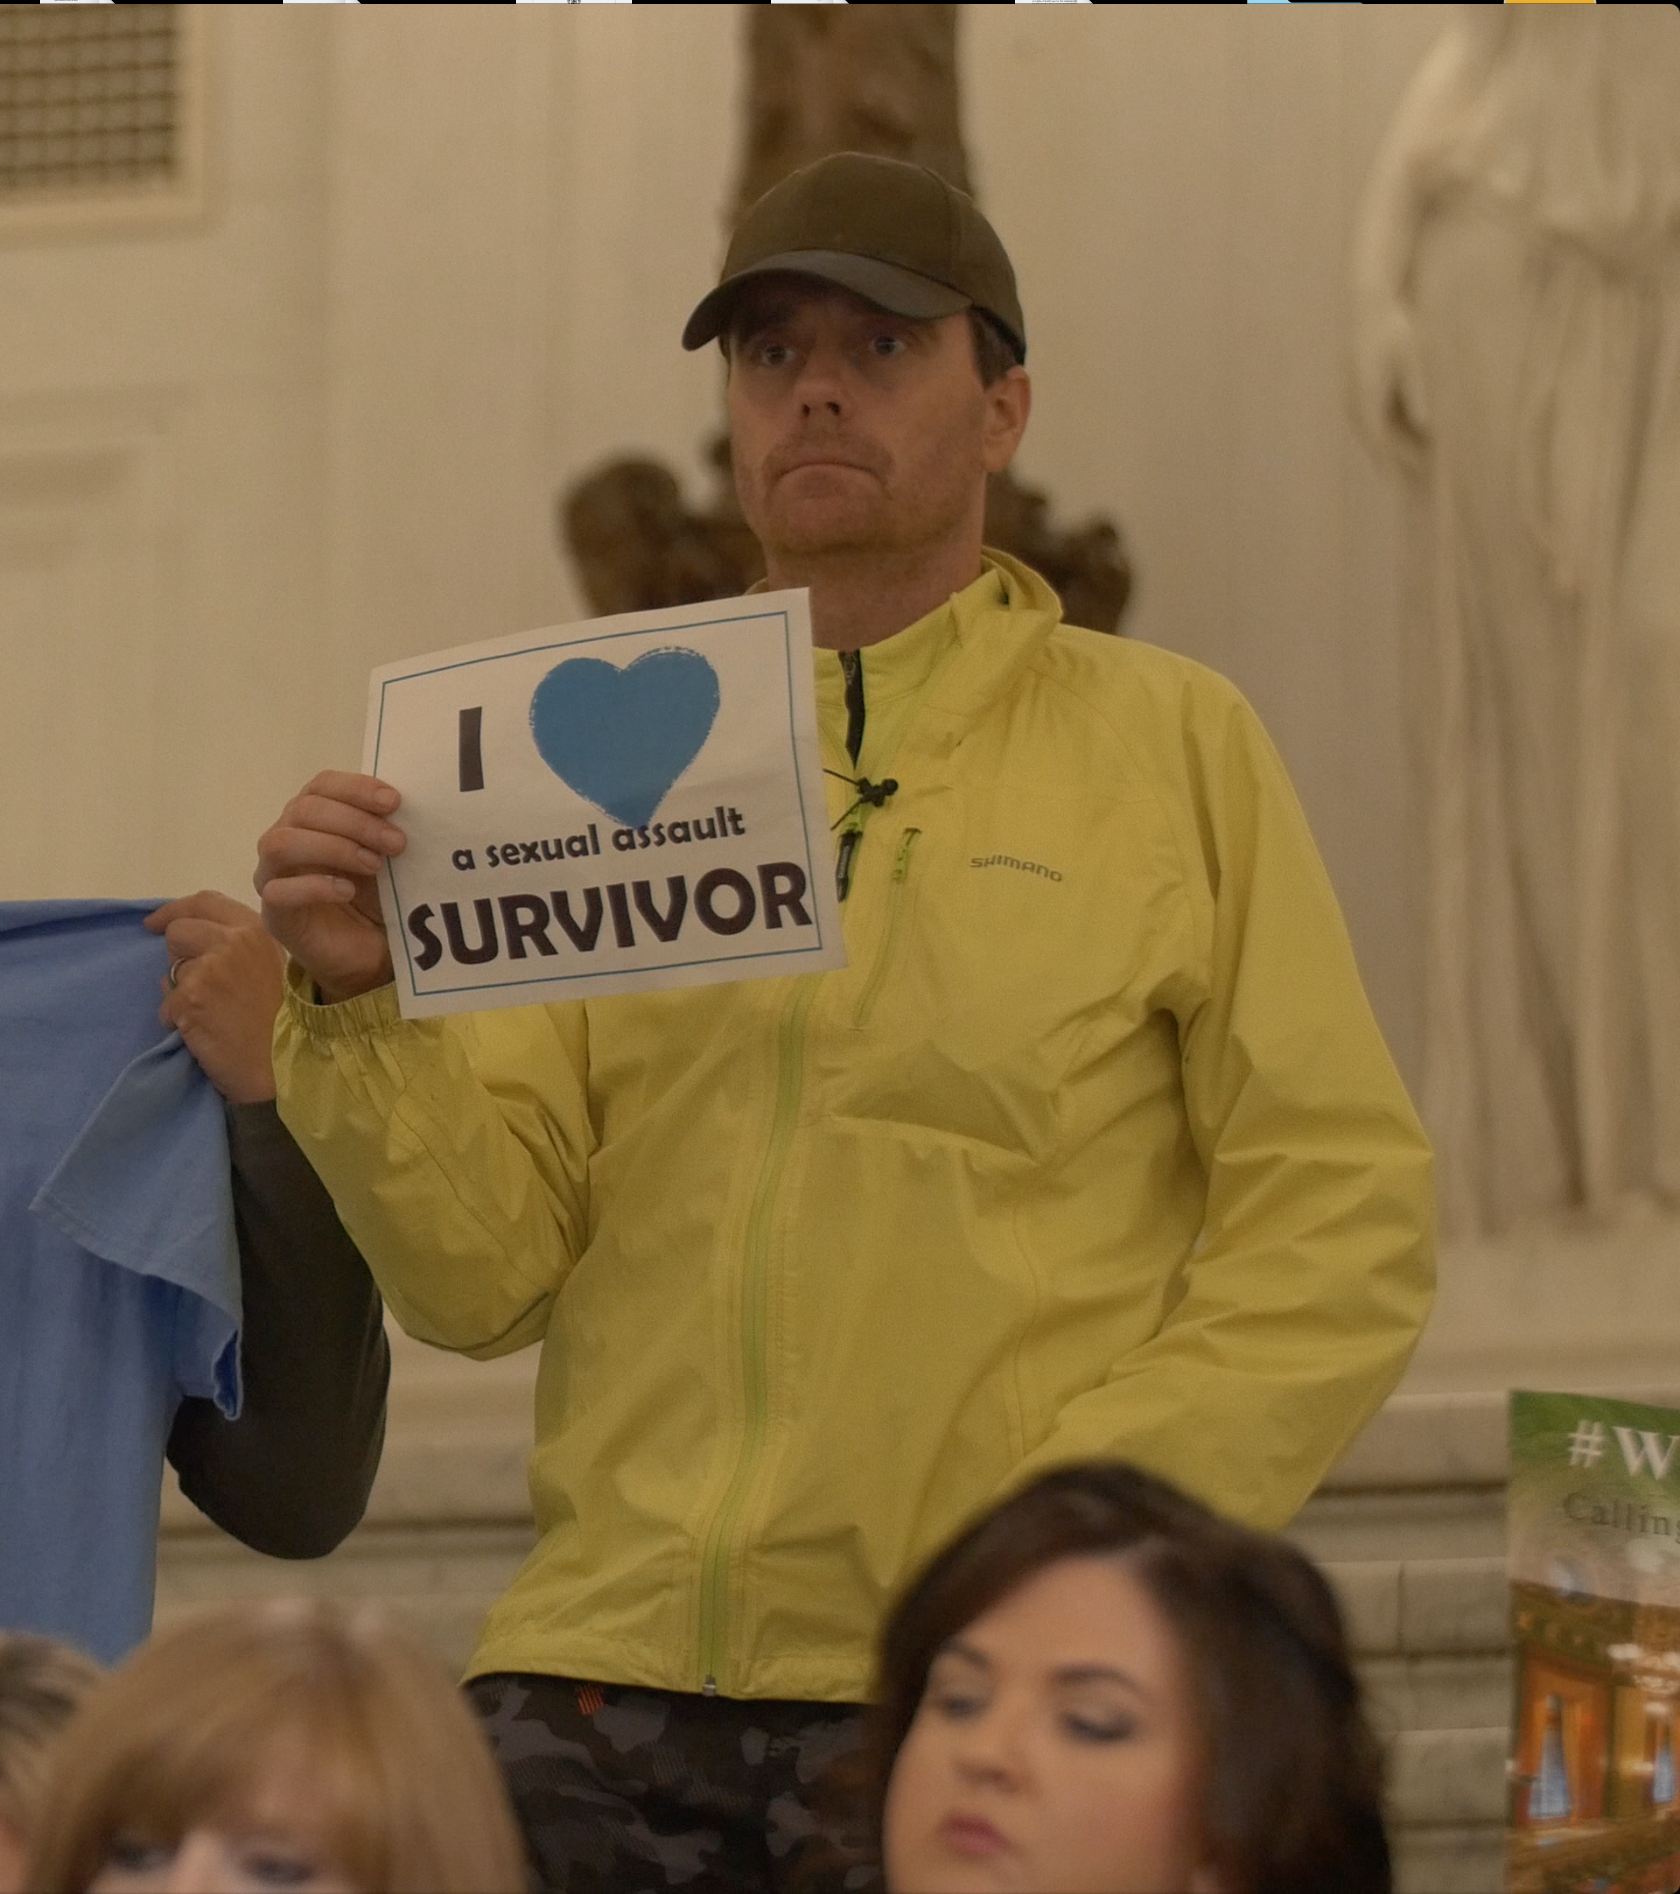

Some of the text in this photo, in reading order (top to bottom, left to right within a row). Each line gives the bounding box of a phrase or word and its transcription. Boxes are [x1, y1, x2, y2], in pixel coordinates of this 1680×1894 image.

[458, 705, 485, 793] I
[451, 805, 747, 872] a sexual assault
[970, 854, 1064, 883] SHIMANO
[407, 861, 814, 972] SURVIVOR
[1563, 1491, 1680, 1544] Callin
